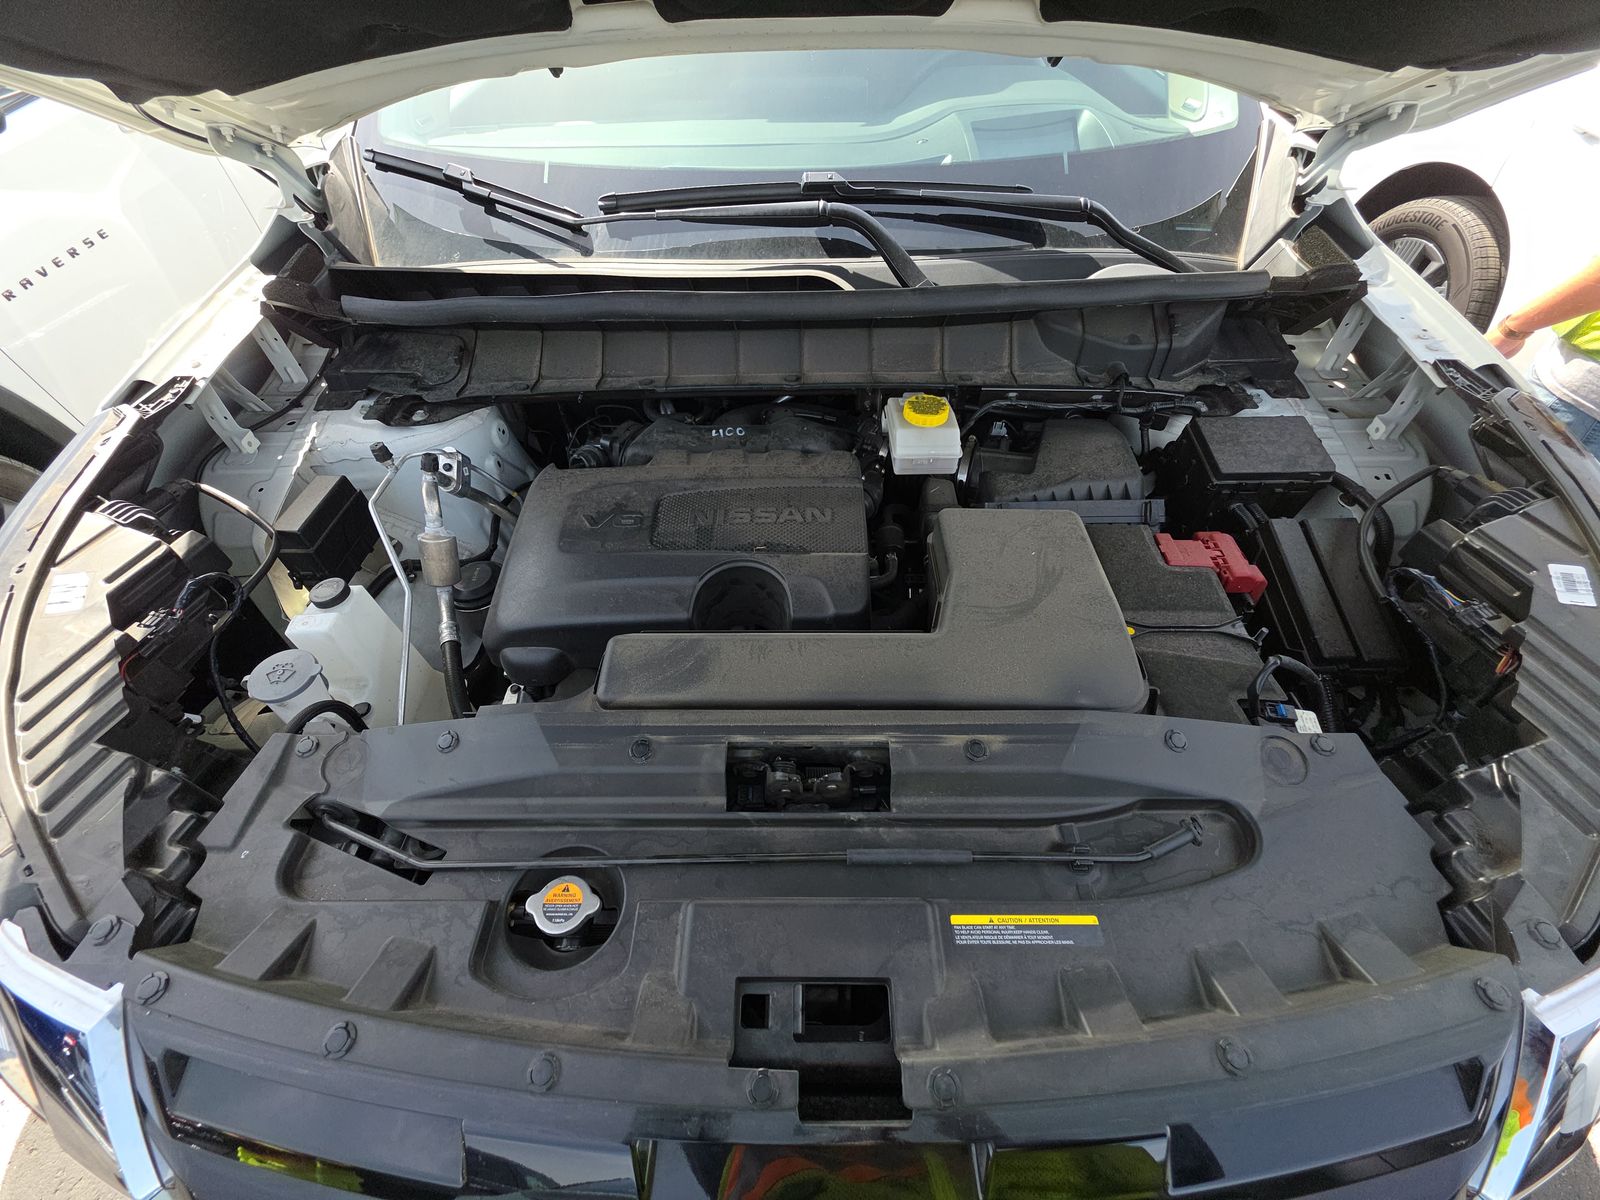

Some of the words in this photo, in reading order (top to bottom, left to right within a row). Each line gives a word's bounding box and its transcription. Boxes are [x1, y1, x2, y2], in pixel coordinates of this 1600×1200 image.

[1, 228, 109, 302] RAVERSE
[582, 511, 643, 529] V6
[687, 506, 833, 526] NISSAN
